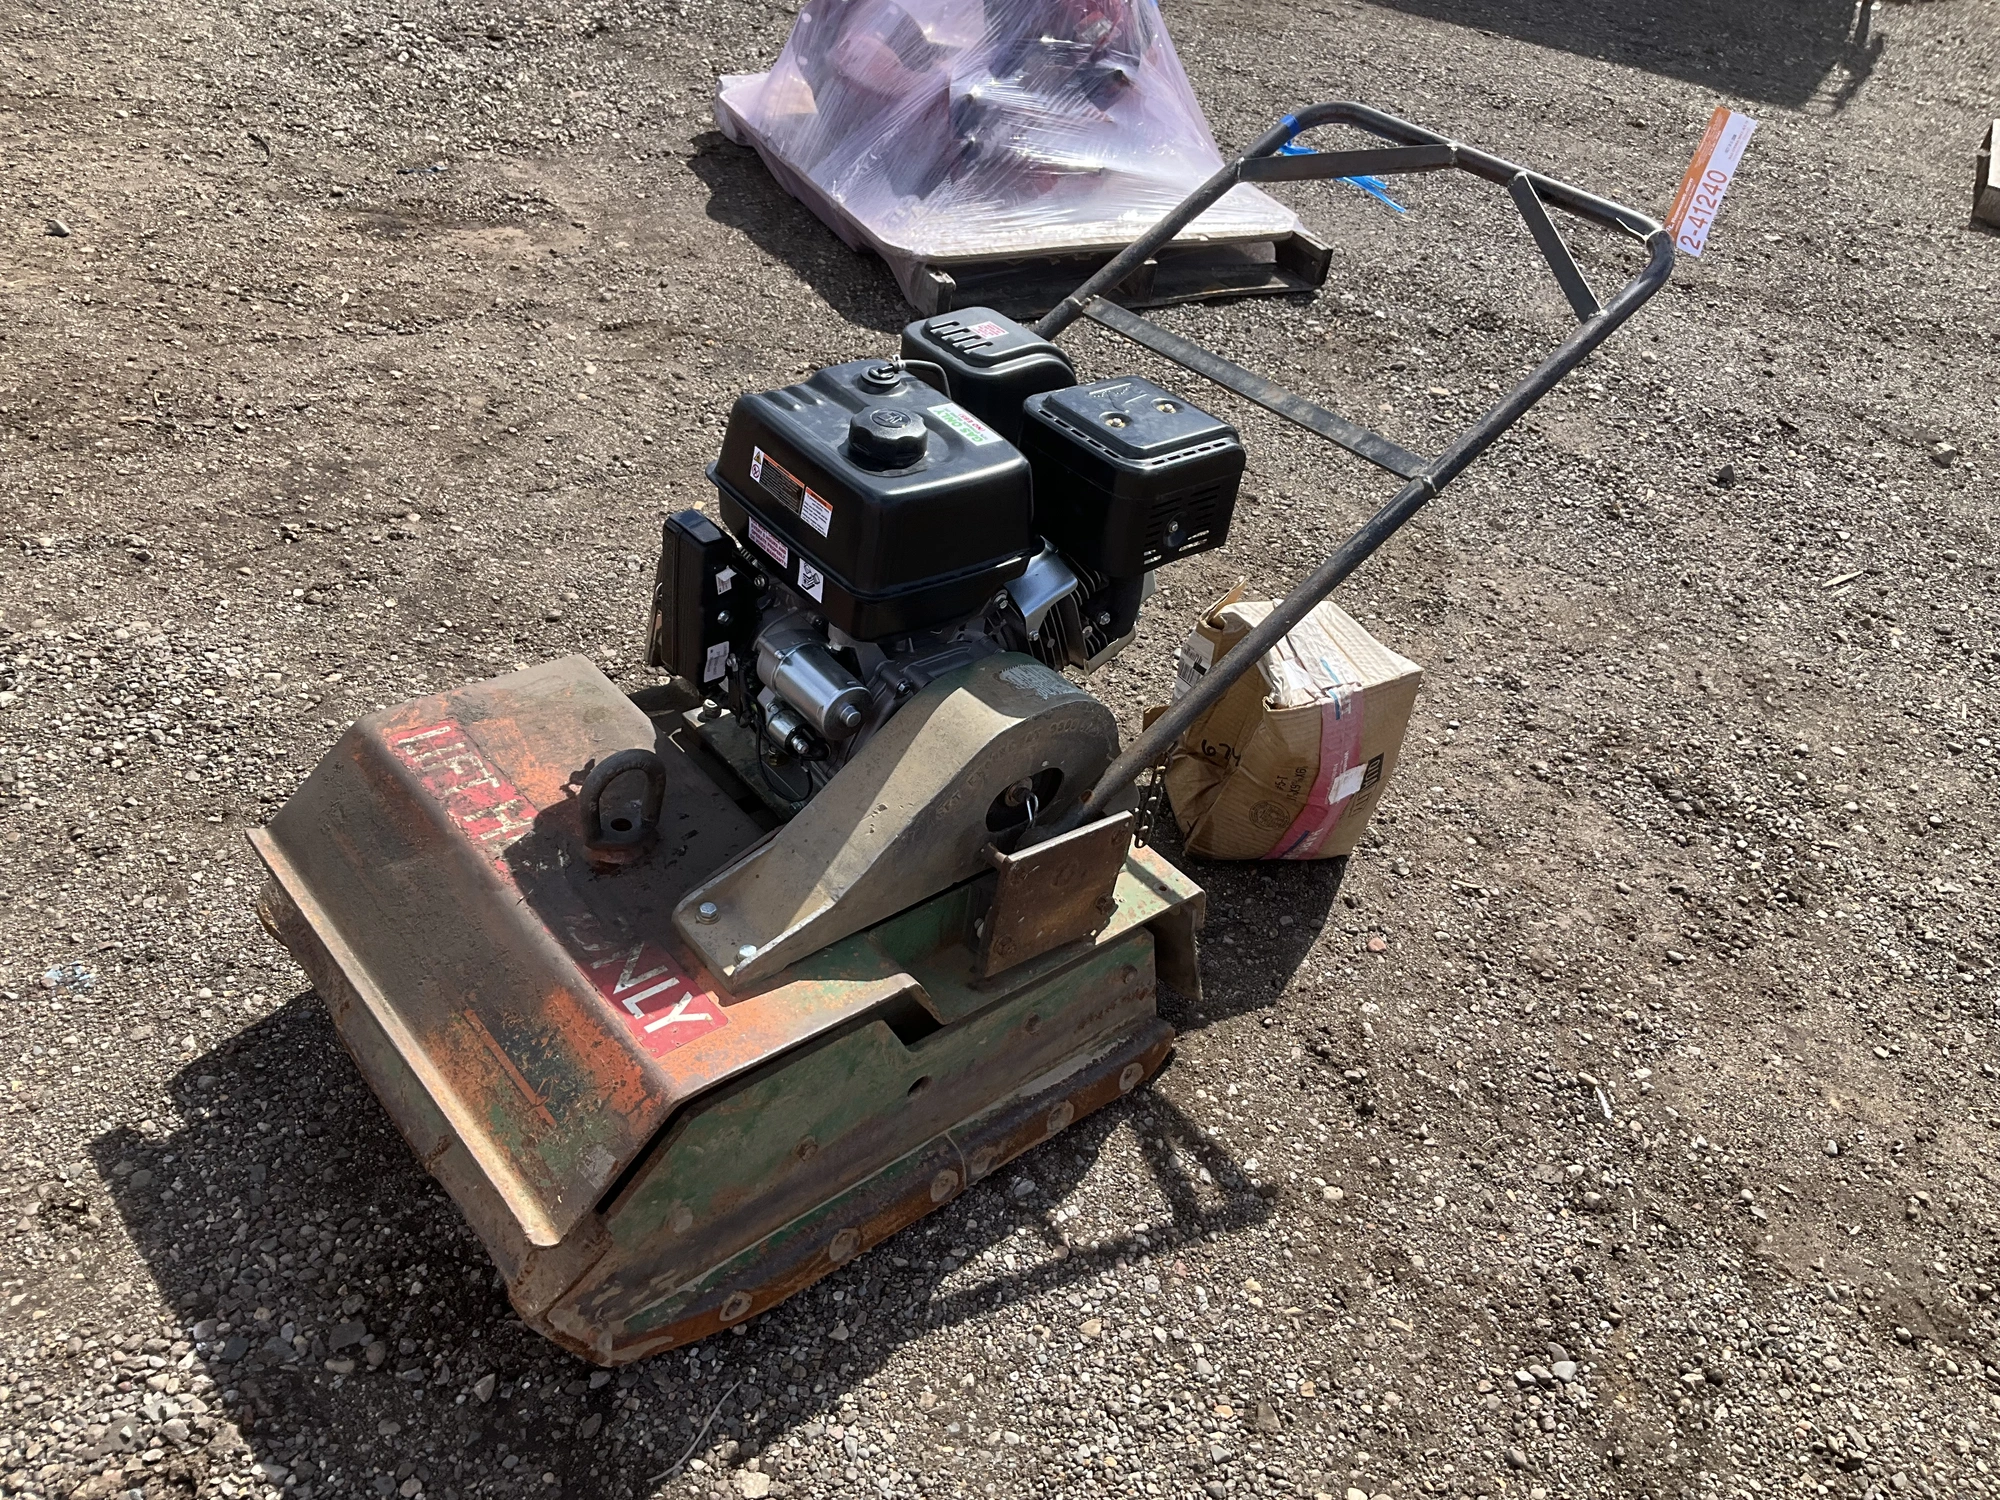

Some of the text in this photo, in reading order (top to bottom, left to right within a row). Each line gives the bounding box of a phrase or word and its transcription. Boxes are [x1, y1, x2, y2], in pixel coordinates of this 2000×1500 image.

[1680, 169, 1728, 251] 2-41240
[933, 408, 963, 429] ONLY
[960, 426, 984, 443] GAS
[766, 547, 787, 566] WARRANTY
[397, 725, 500, 796] LIFT
[1201, 739, 1242, 767] 674
